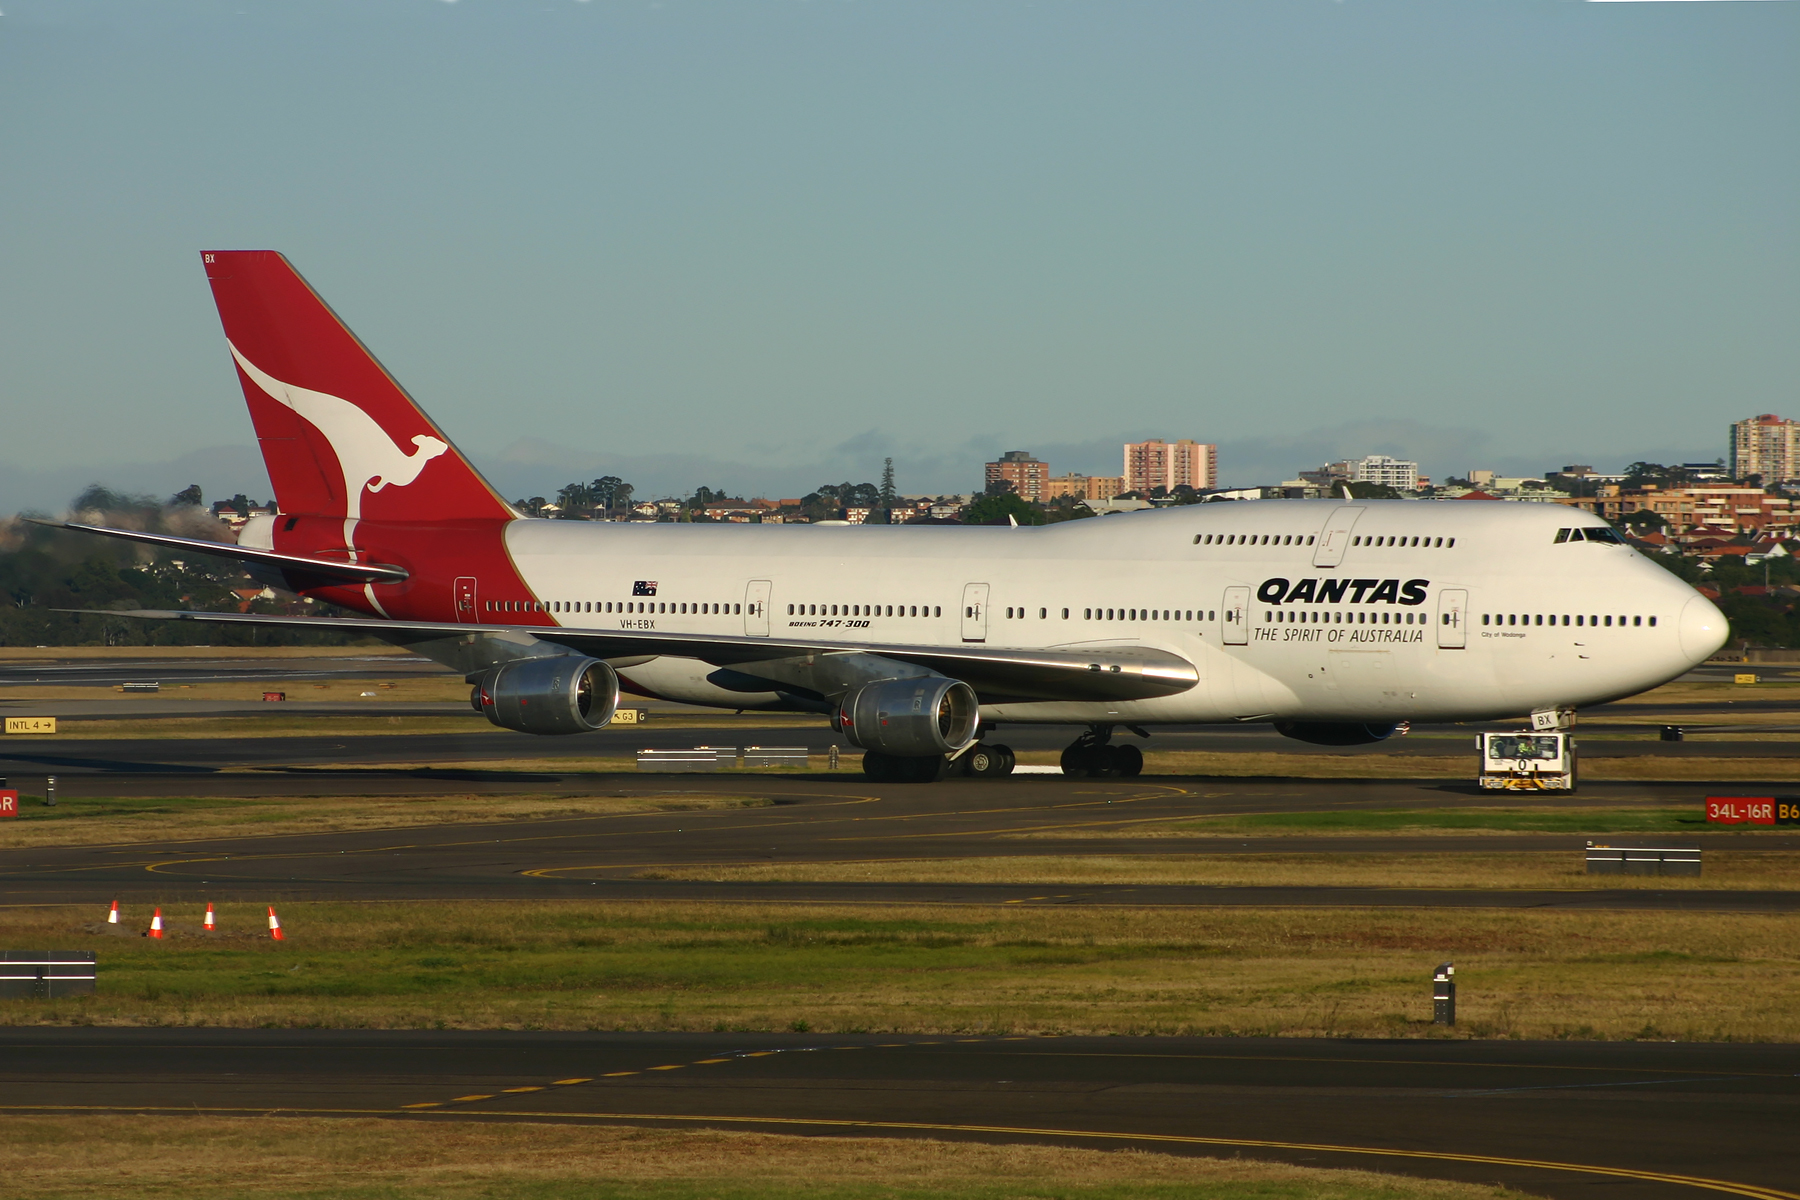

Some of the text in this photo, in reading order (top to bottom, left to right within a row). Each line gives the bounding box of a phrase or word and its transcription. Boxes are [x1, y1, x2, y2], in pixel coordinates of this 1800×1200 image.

[205, 253, 215, 263] BX
[1256, 577, 1430, 606] QANTAS
[620, 619, 655, 629] VH-EBX
[820, 619, 870, 628] 747-300
[1254, 627, 1423, 642] THE SPIRIT OF AUSTRALIA
[622, 712, 645, 721] G3 G
[1538, 714, 1552, 726] BX
[9, 721, 30, 730] INTL
[33, 721, 39, 730] 4
[0, 796, 13, 811] R
[1709, 803, 1800, 819] 34L-16R B6
